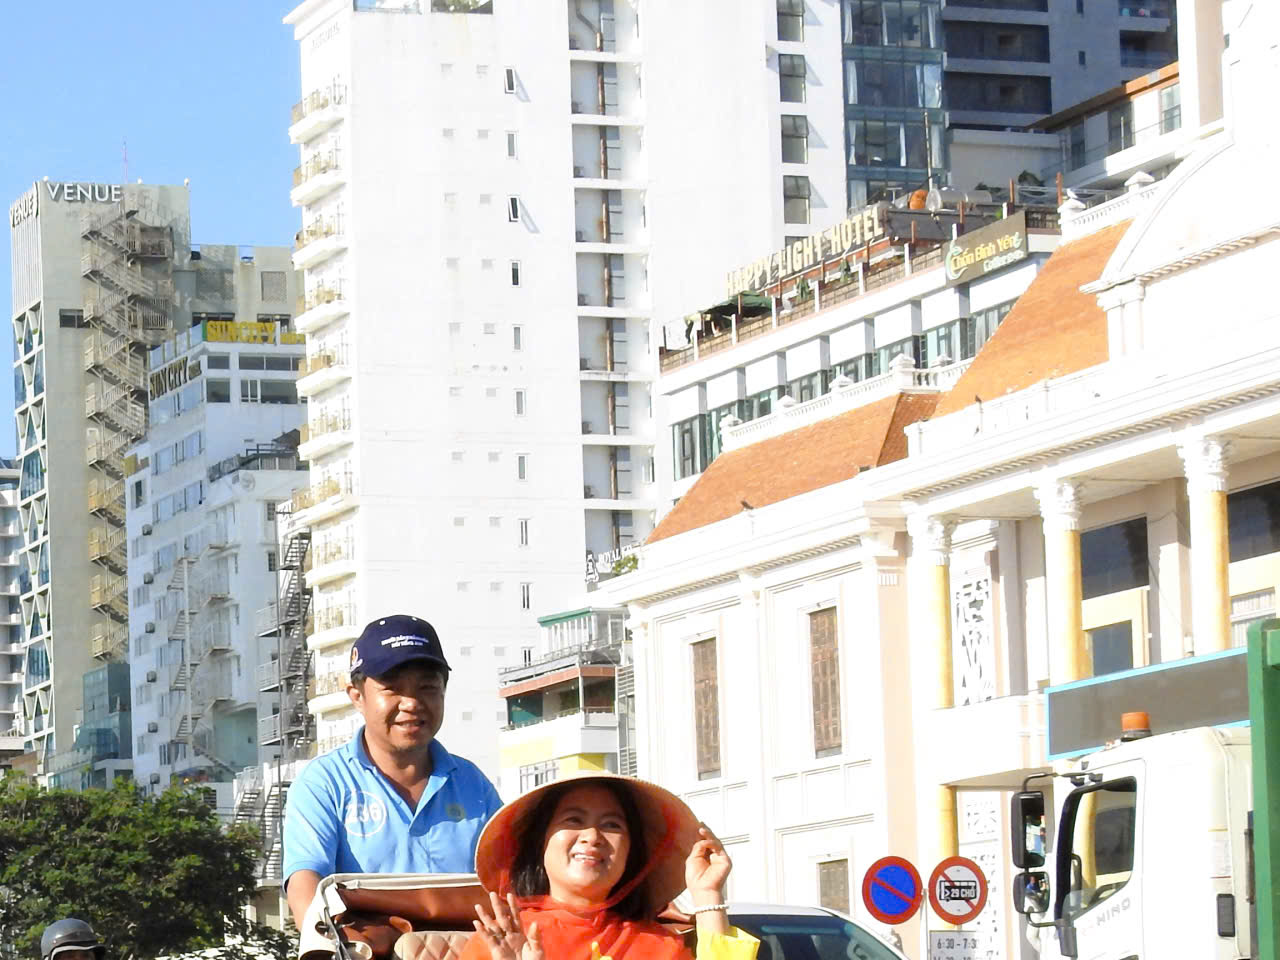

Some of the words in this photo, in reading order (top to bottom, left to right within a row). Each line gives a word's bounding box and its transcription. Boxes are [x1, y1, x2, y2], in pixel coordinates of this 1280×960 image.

[46, 183, 121, 202] VENUE
[726, 254, 773, 296] HAPPY
[777, 231, 827, 278] LIGHT
[830, 205, 884, 256] HOTEL
[1096, 896, 1131, 926] HINO
[937, 938, 955, 949] 6:30
[963, 938, 978, 949] 7:3
